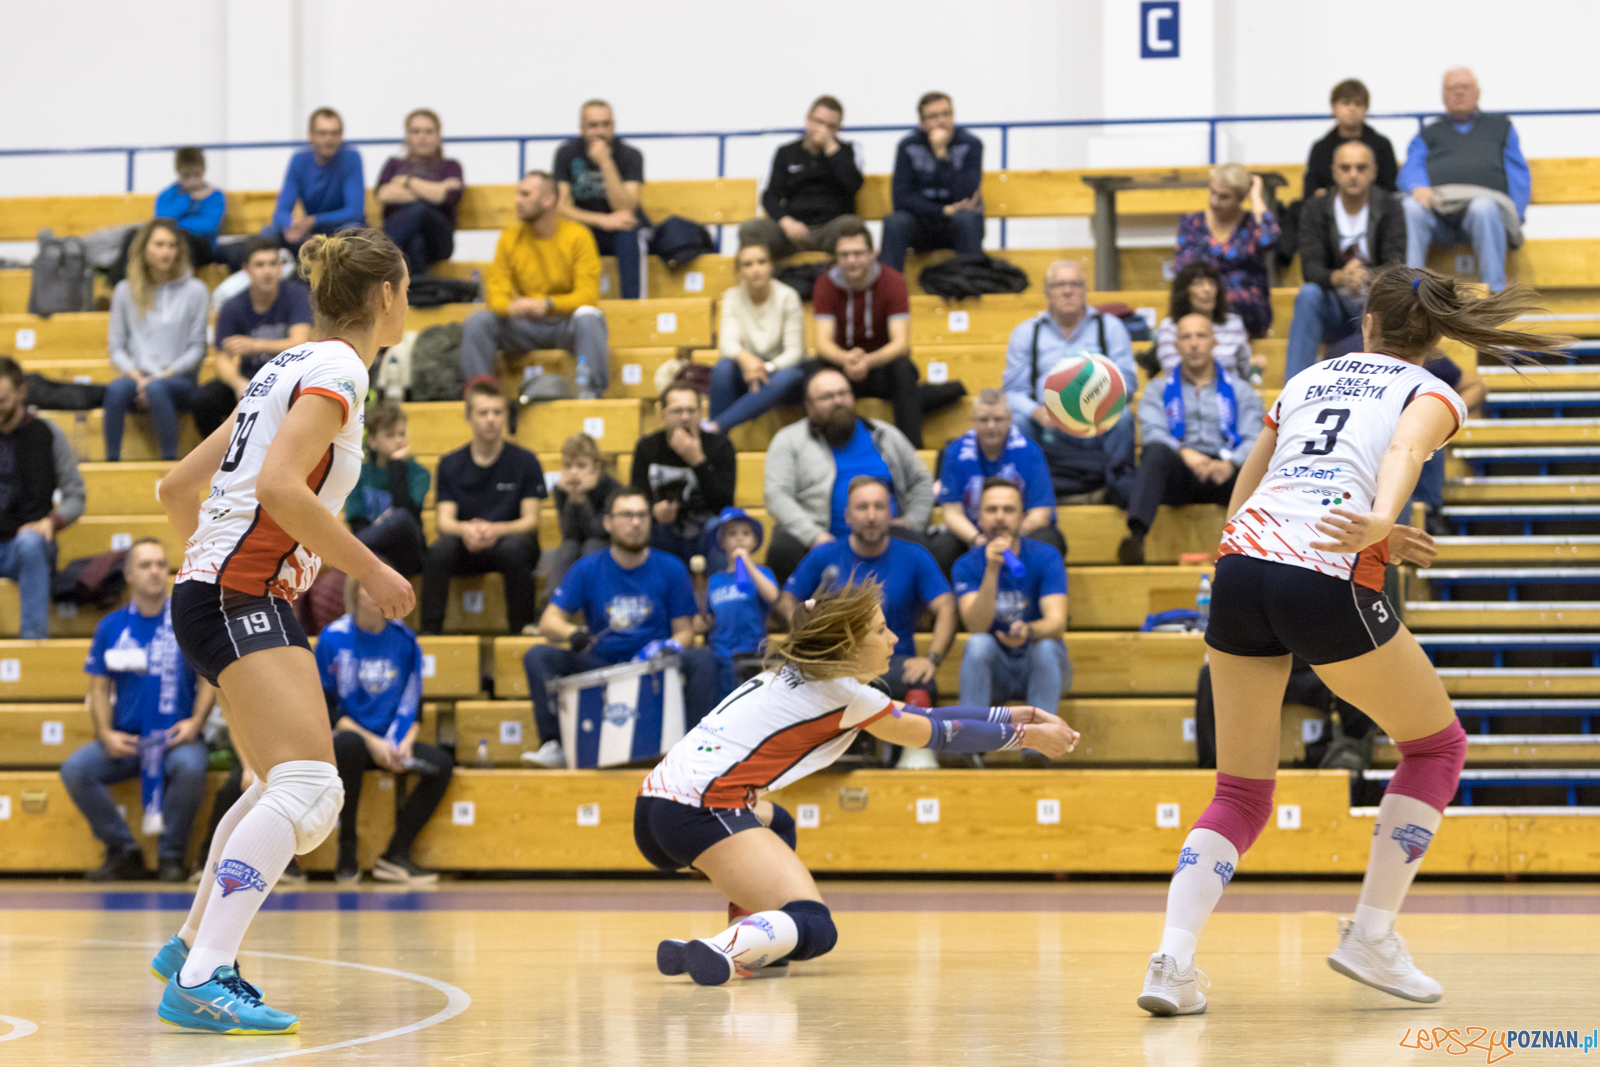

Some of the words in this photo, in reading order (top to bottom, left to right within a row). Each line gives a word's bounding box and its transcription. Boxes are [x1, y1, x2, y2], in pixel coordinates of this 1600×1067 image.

[1147, 7, 1174, 50] C
[1322, 359, 1407, 374] JURCZYK
[1335, 377, 1371, 386] ENEA
[1304, 385, 1388, 401] ENERGETYK
[1301, 408, 1350, 455] 3
[1372, 600, 1389, 623] 3
[236, 611, 271, 635] 19
[227, 861, 252, 875] ENEA
